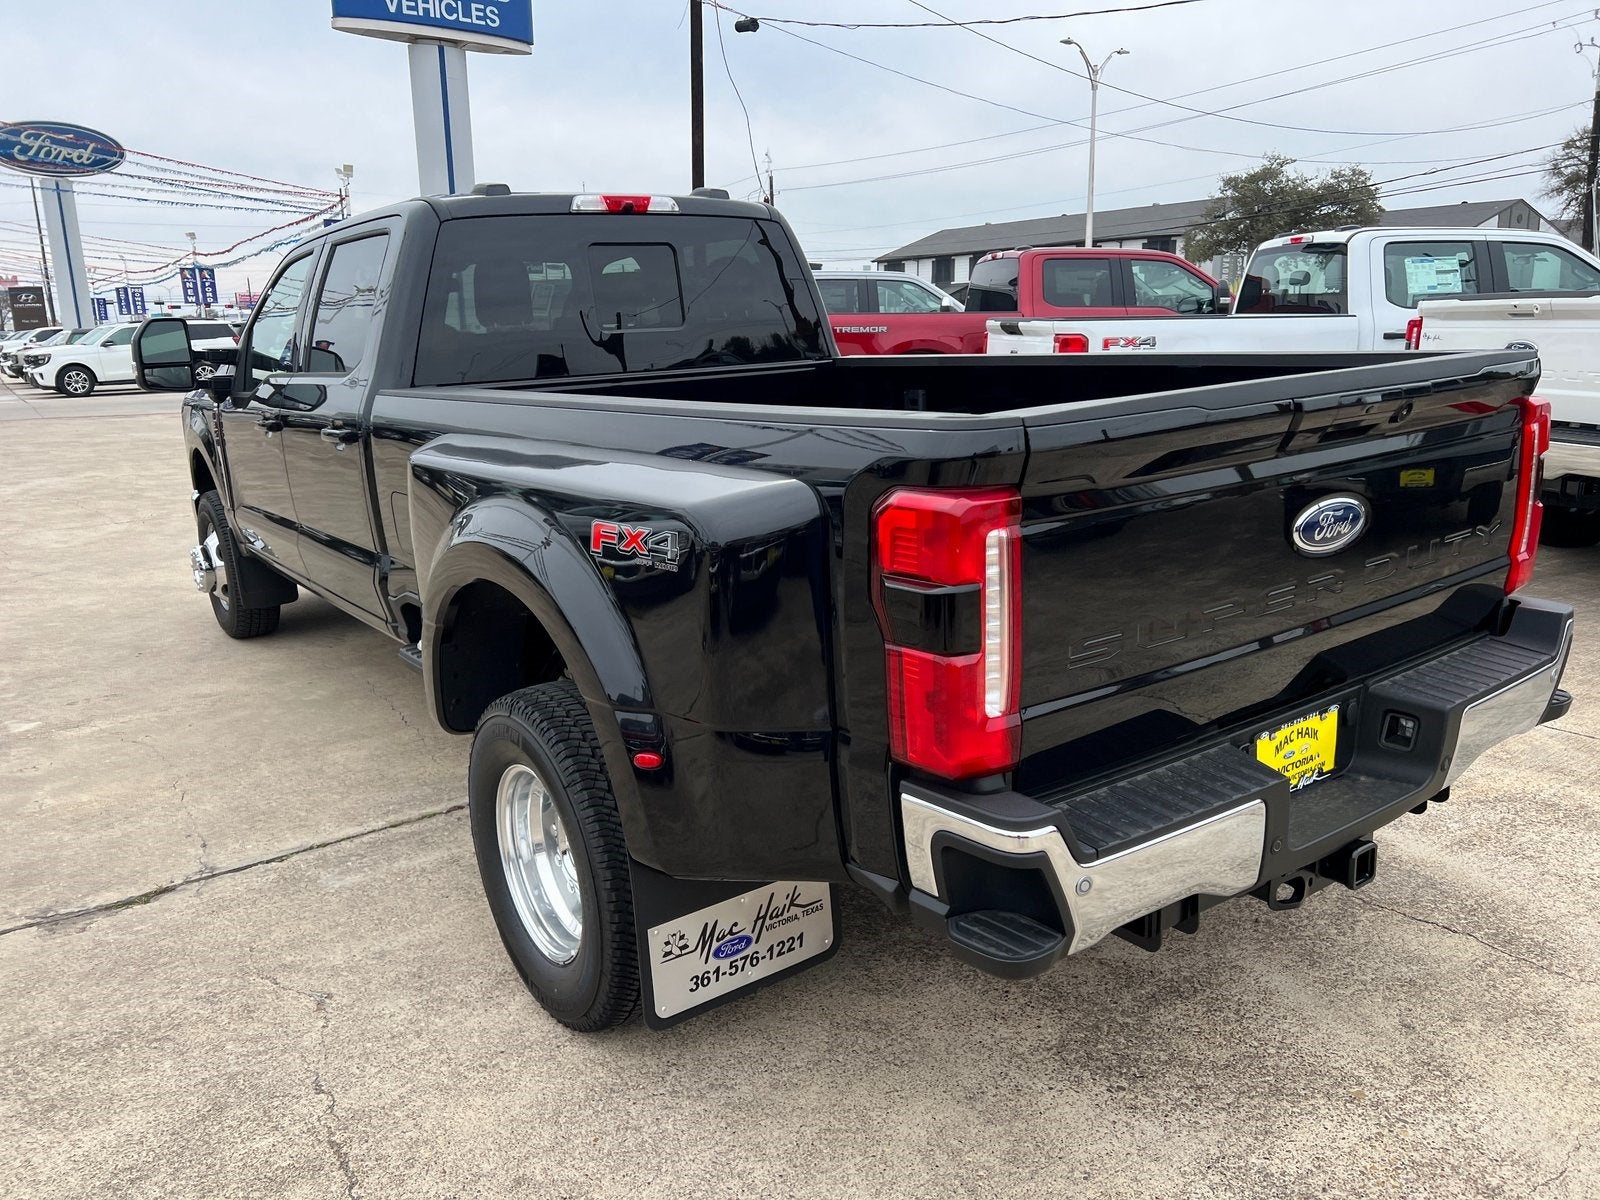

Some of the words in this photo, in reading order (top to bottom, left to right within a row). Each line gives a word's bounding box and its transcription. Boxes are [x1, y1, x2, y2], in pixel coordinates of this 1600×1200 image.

[385, 0, 500, 27] VEHICLES
[13, 130, 95, 165] Ford
[186, 281, 196, 302] NEW
[205, 281, 214, 302] FORD
[1102, 336, 1156, 350] FX4
[1314, 509, 1354, 541] Ford
[589, 518, 680, 565] FX4
[1066, 567, 1345, 671] SUPER
[1363, 517, 1503, 585] DUTY
[1274, 730, 1295, 757] MAC
[1296, 727, 1319, 741] HAIK
[694, 919, 746, 965] Mac
[752, 885, 823, 944] Haik
[765, 914, 801, 932] VICTORIA,
[801, 903, 824, 918] TEXAS
[688, 931, 805, 994] 361-576-1221
[719, 939, 747, 958] Ford
